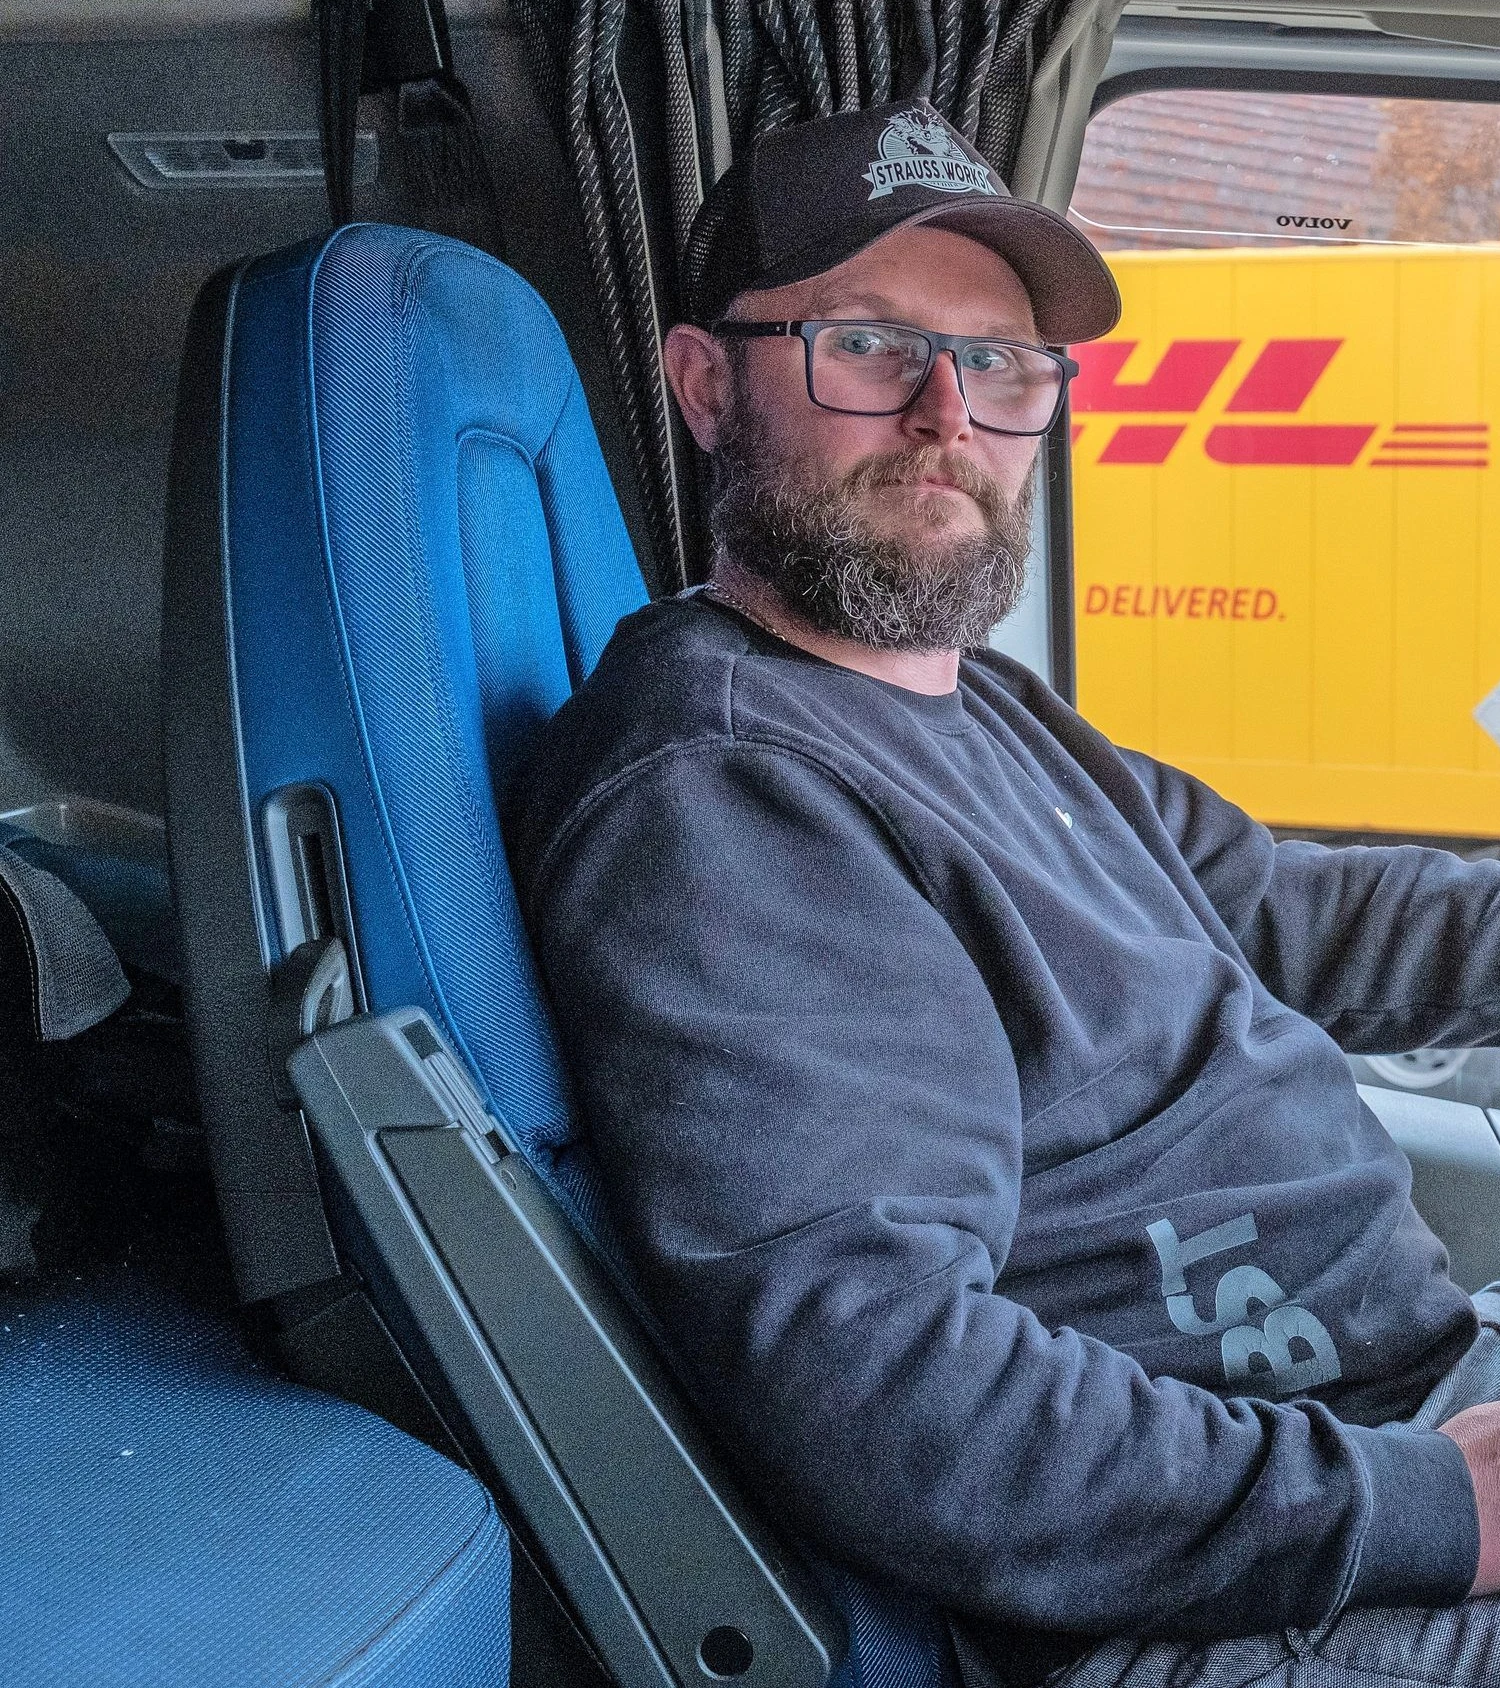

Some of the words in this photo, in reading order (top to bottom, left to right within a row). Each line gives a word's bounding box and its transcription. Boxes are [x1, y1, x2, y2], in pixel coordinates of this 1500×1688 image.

[876, 159, 986, 190] STRAUSS.WORKS
[1085, 584, 1287, 622] DELIVERED.
[1145, 1212, 1343, 1395] BST
